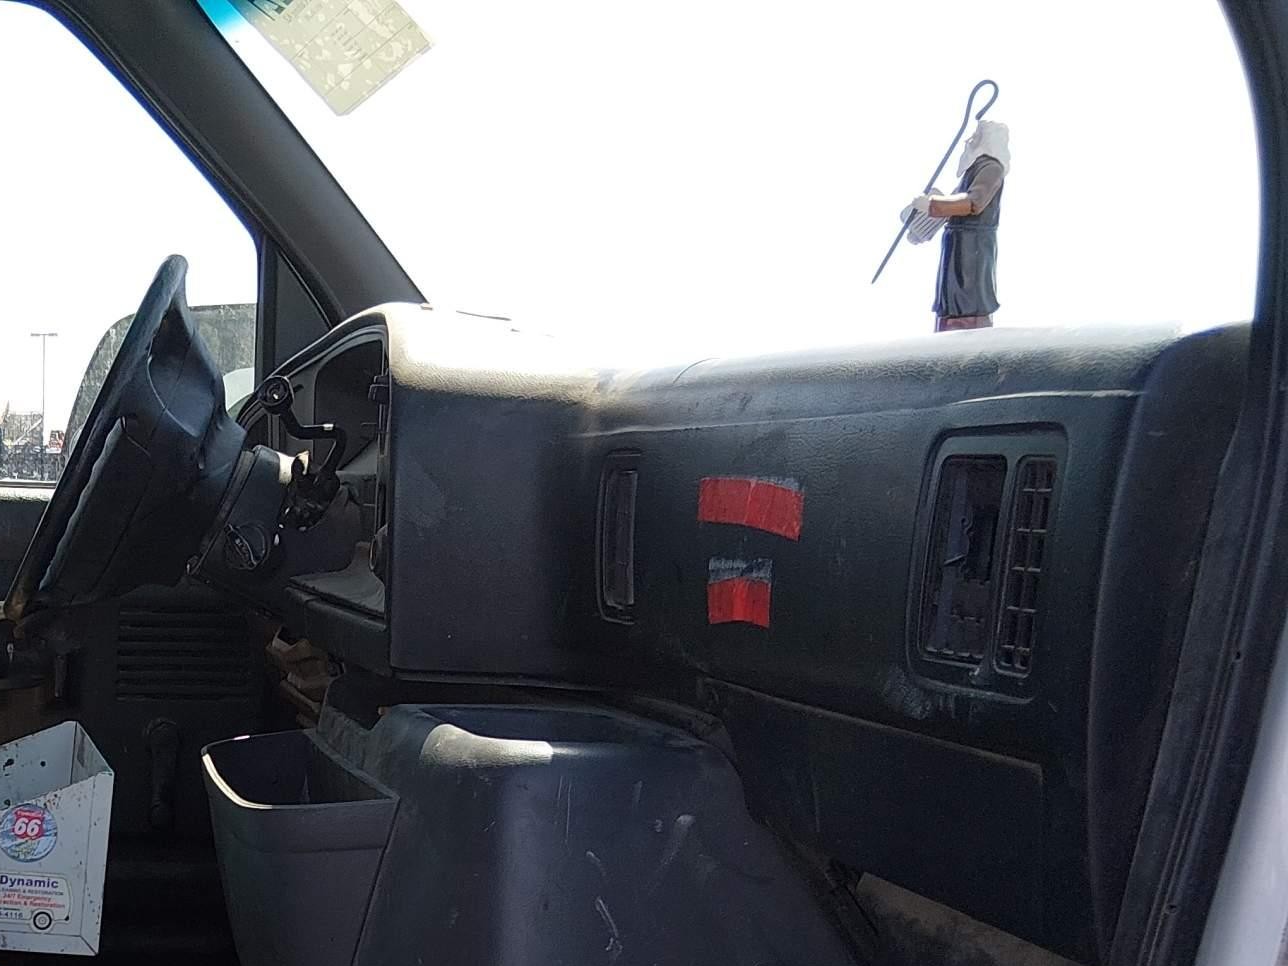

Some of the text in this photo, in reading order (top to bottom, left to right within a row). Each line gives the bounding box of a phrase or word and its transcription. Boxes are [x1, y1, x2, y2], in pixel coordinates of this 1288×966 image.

[14, 817, 42, 837] 66
[0, 874, 59, 889] Dynamic
[17, 894, 52, 902] Emergency
